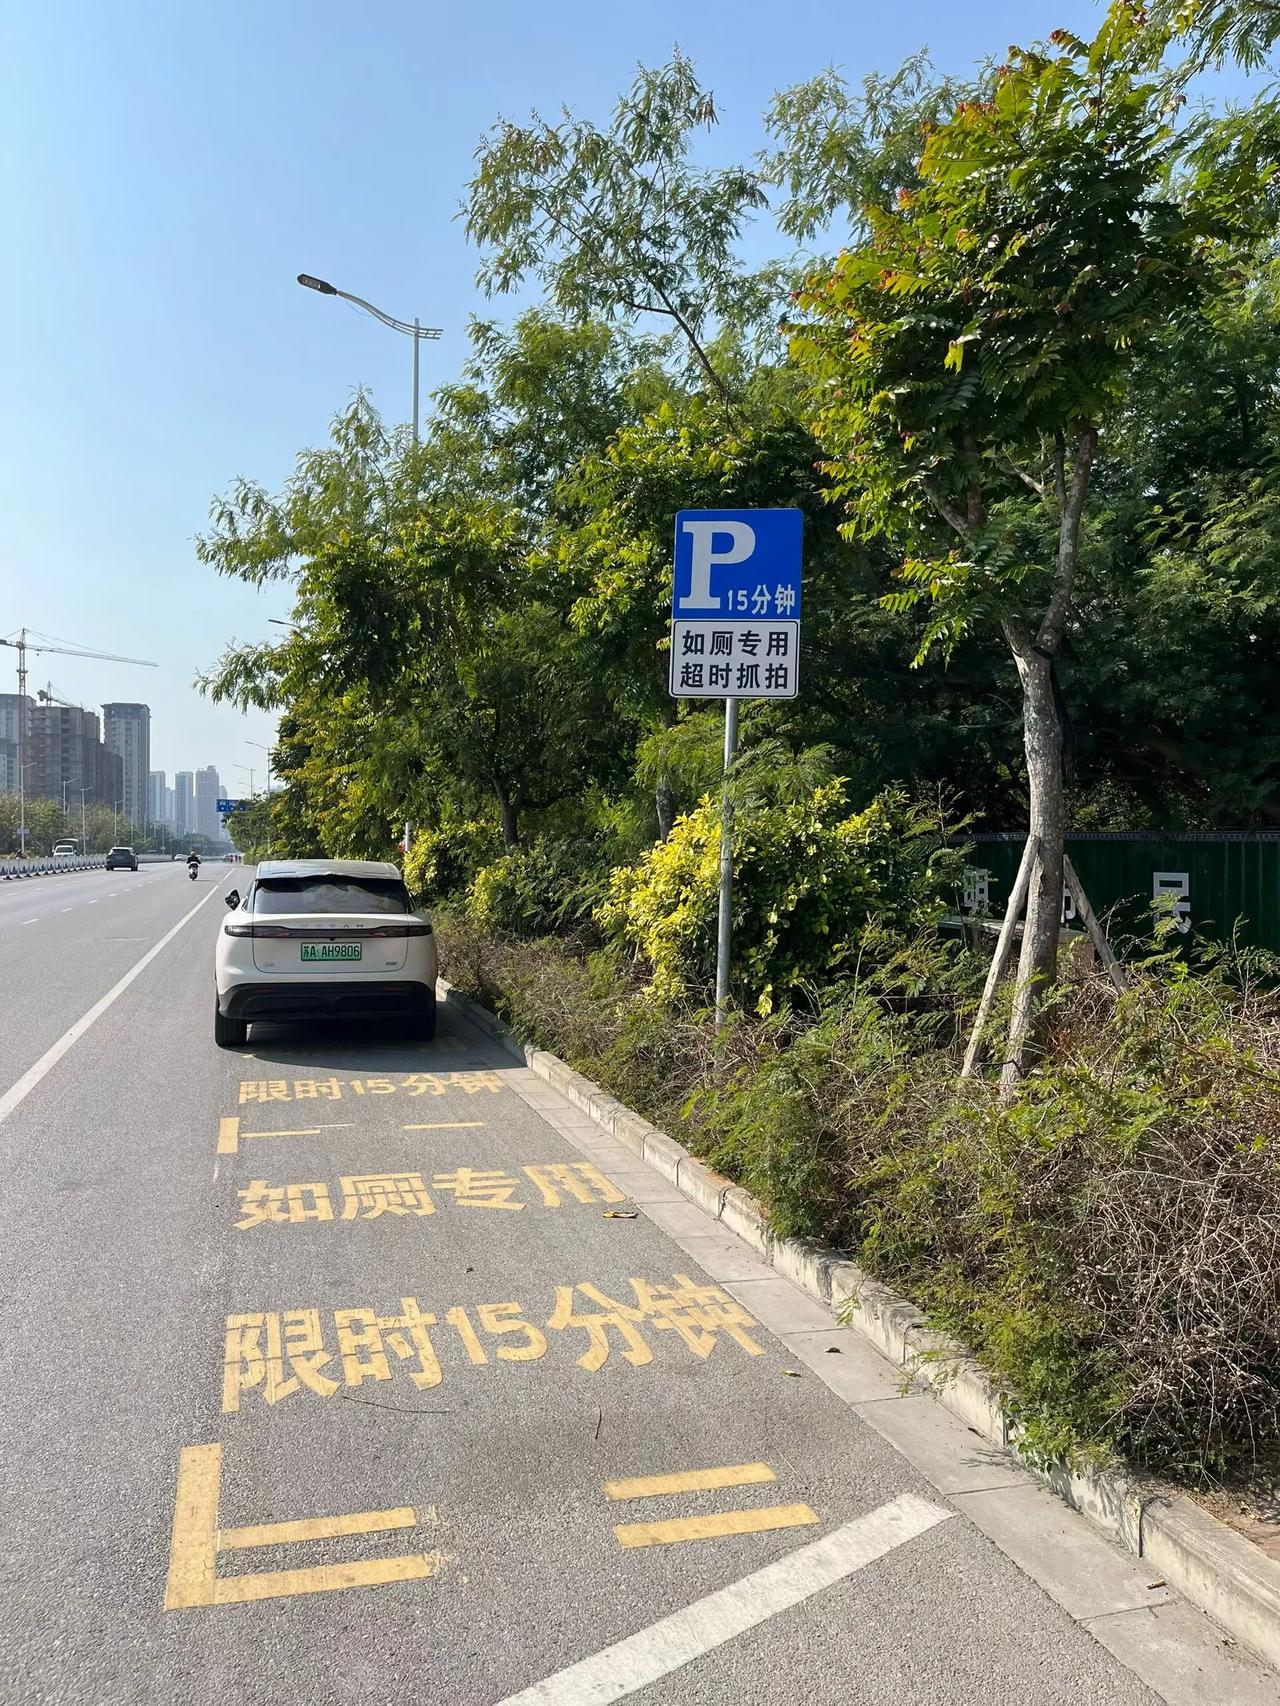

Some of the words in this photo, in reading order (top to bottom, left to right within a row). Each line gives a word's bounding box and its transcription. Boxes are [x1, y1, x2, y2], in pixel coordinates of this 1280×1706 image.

[678, 520, 756, 609] P
[727, 584, 796, 616] 15分钟
[681, 630, 789, 657] 如厕专用
[679, 662, 789, 689] 超时抓拍
[321, 945, 360, 958] AH9806
[238, 1071, 504, 1104] 限时15分钟
[233, 1162, 627, 1230] 如厕专用
[222, 1273, 765, 1413] 限时15分钟
